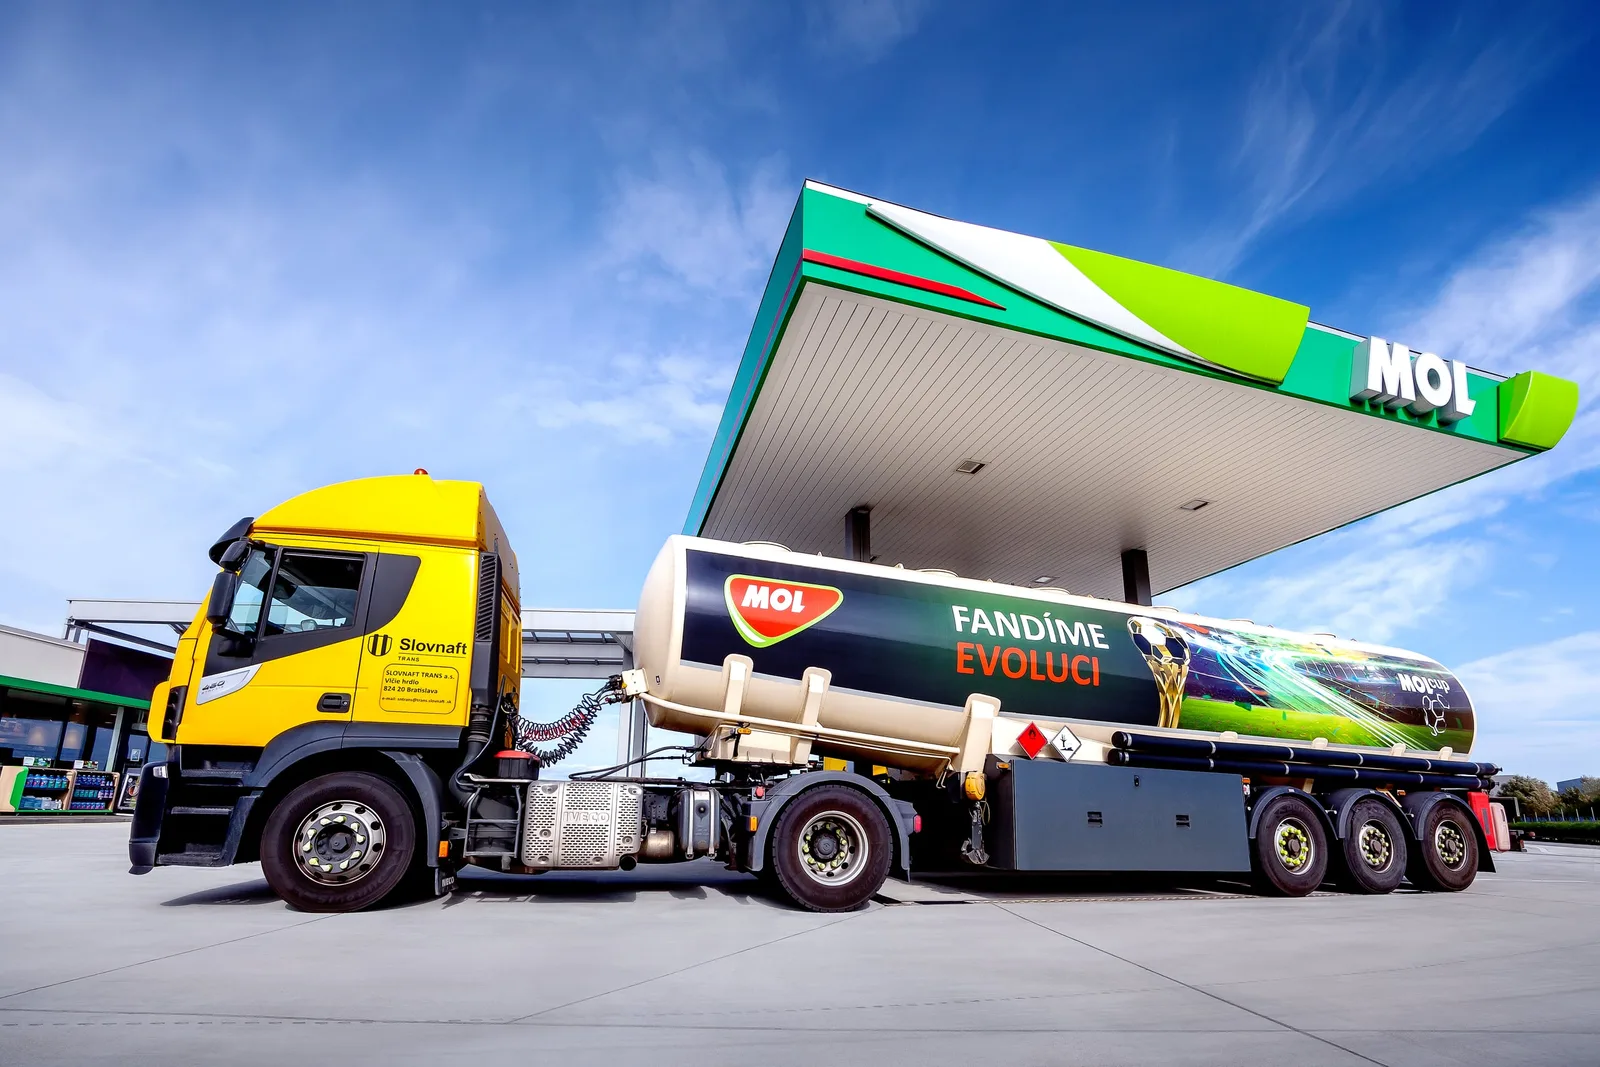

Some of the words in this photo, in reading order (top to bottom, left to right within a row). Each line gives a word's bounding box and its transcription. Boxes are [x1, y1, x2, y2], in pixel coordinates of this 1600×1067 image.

[1367, 335, 1476, 416] MOL
[741, 584, 805, 613] MOL
[951, 605, 1110, 650] FANDÍME
[399, 638, 468, 655] Slovnaft
[386, 670, 420, 678] SLOVNAFT
[956, 641, 1100, 687] EVOLUCI
[563, 811, 610, 823] IVECO
